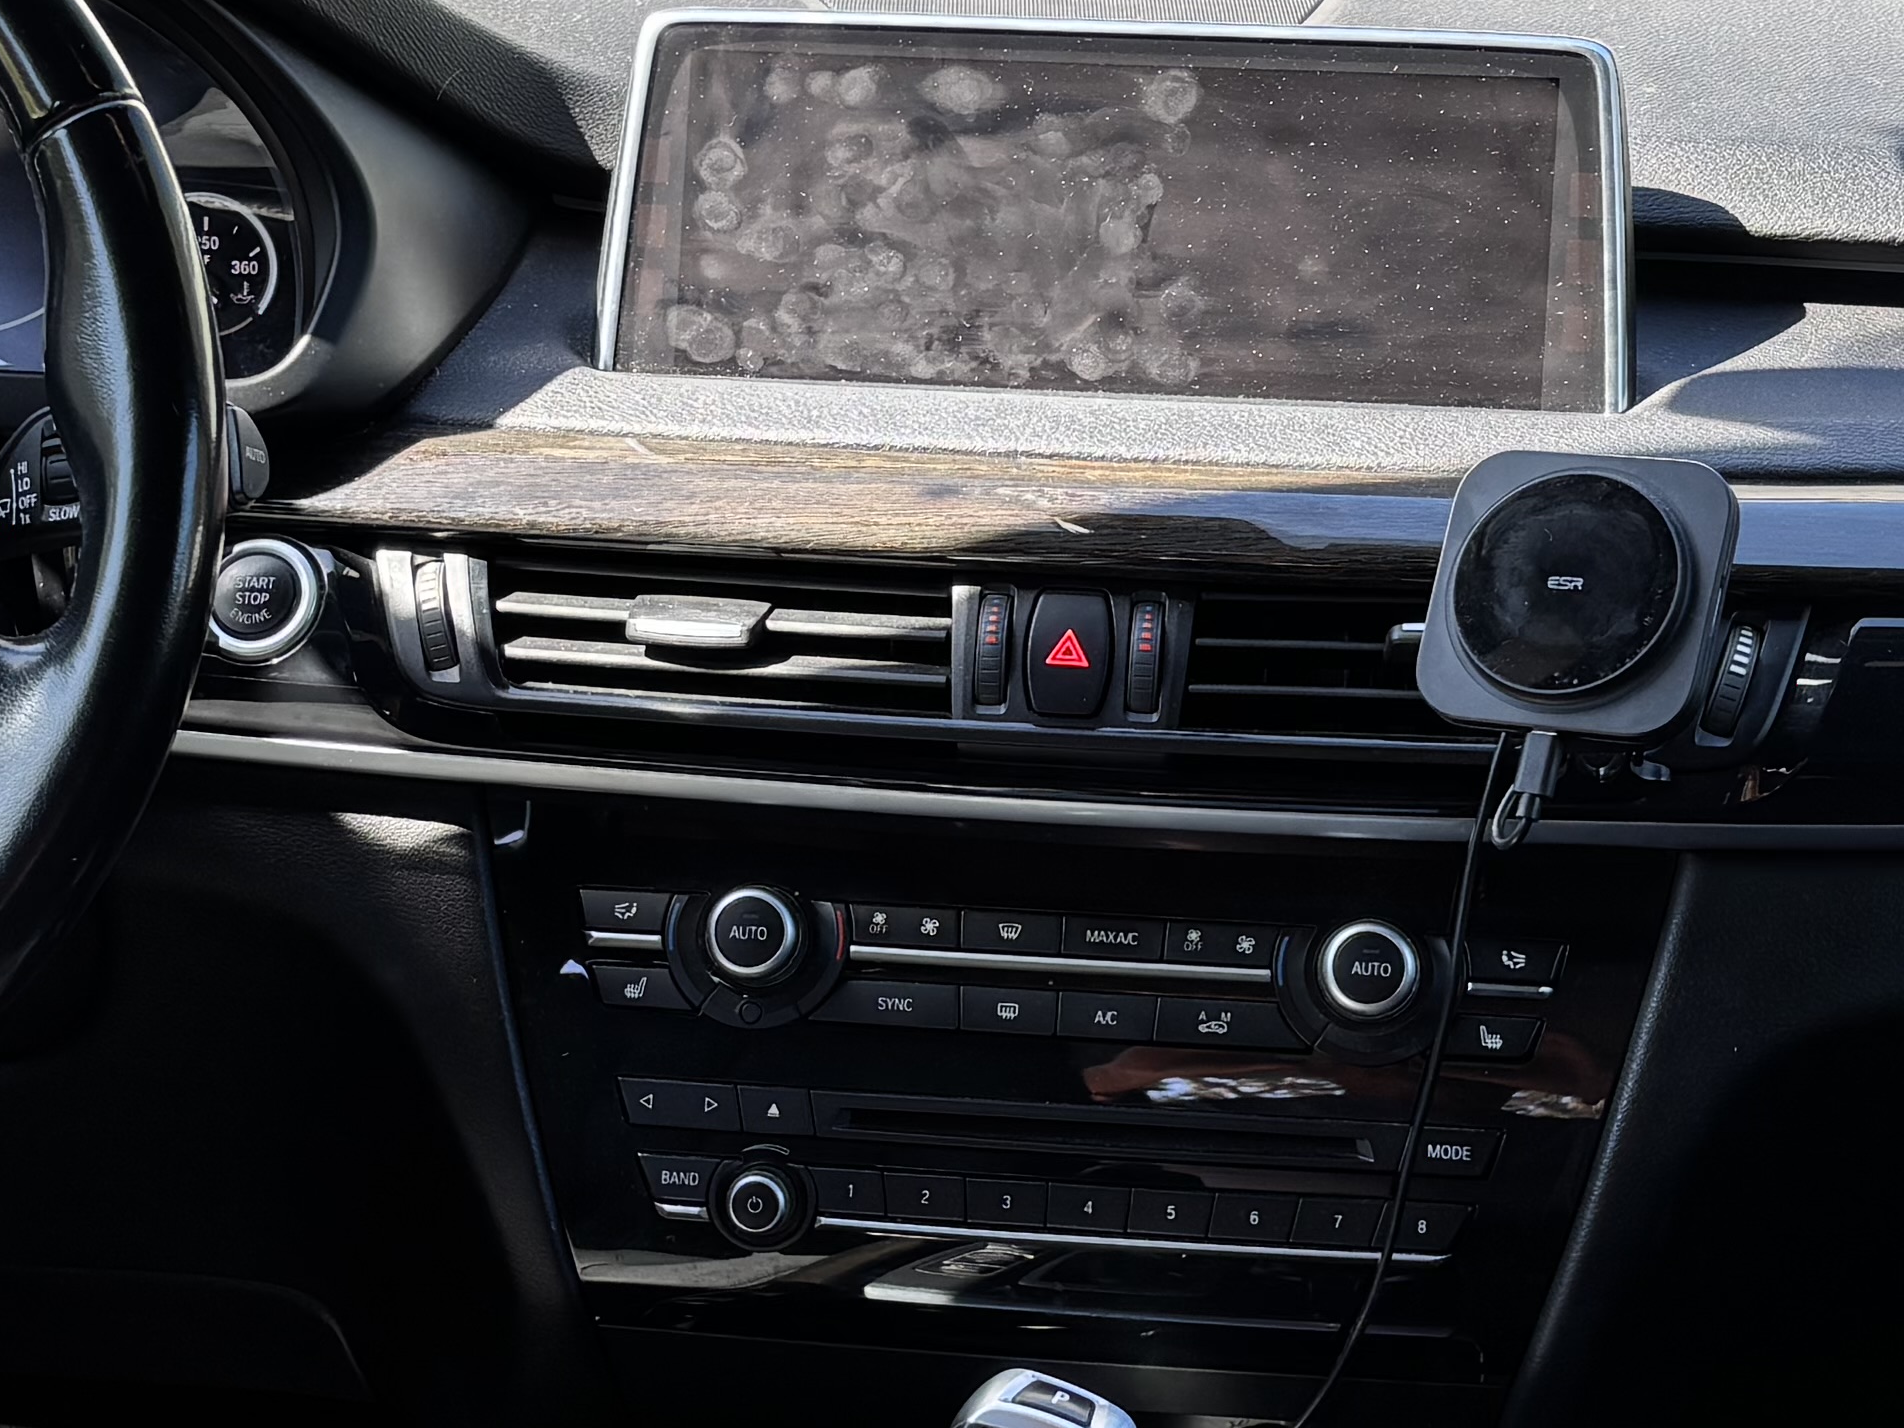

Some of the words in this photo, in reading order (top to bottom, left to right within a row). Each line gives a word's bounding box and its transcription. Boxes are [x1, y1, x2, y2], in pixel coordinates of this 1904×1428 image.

[198, 236, 219, 250] 50
[231, 260, 258, 274] 360
[17, 461, 28, 475] HI
[18, 477, 31, 492] LO
[18, 493, 37, 510] OFF
[234, 576, 276, 589] START
[1547, 576, 1584, 591] ESR
[235, 591, 270, 605] STOP
[229, 607, 272, 624] ENGINE
[729, 924, 768, 942] AUTO
[869, 923, 888, 934] OFF
[1183, 941, 1203, 951] OFF
[1351, 961, 1391, 977] AUTO
[877, 996, 913, 1012] SYNC
[1094, 1010, 1118, 1025] A/C
[1198, 1010, 1207, 1021] A
[1220, 1011, 1231, 1022] M
[1427, 1144, 1472, 1161] MODE
[660, 1170, 699, 1186] BAND
[921, 1190, 929, 1204] 2
[1002, 1195, 1011, 1209] 3
[1083, 1200, 1093, 1214] 4
[1167, 1205, 1175, 1220] 5
[1250, 1211, 1259, 1225] 6
[1334, 1215, 1342, 1229] 7
[1418, 1220, 1427, 1234] 8
[1051, 1390, 1070, 1404] P
